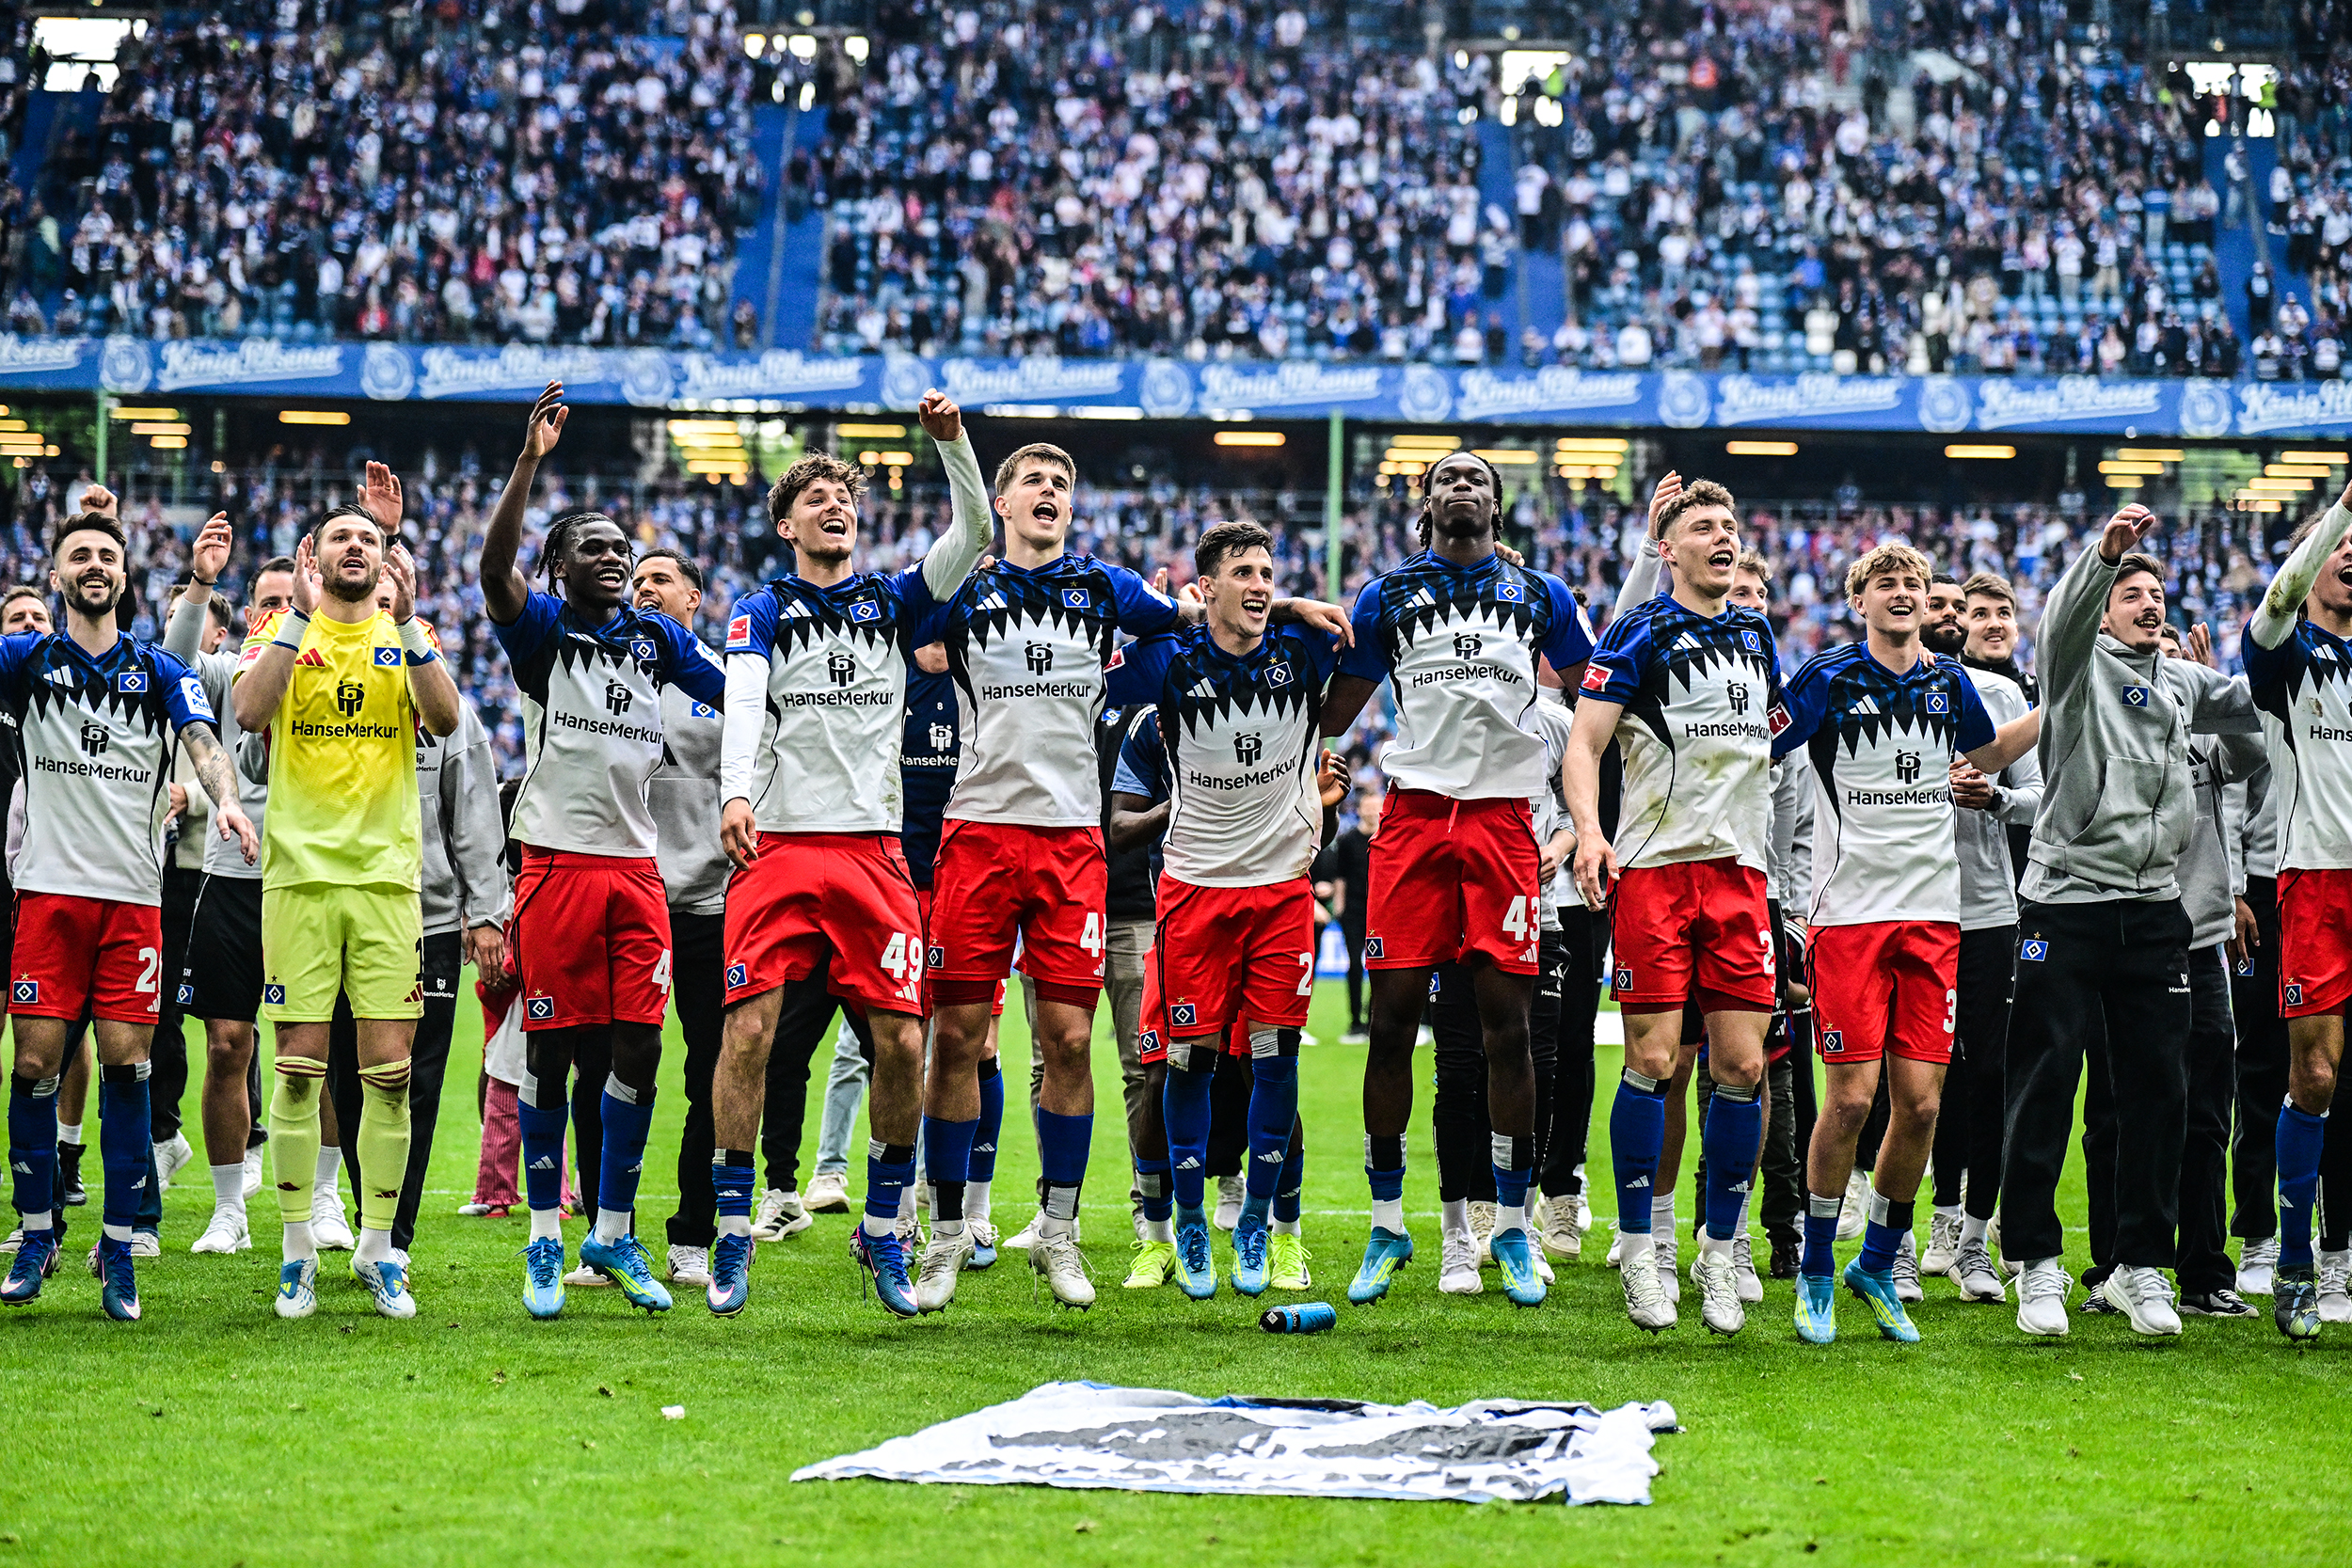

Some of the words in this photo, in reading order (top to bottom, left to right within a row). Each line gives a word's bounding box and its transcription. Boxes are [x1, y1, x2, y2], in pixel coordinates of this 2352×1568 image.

[982, 682, 1091, 701] HanseMerkur
[1412, 664, 1523, 688] HanseMerkur
[782, 691, 894, 707] HanseMerkur
[937, 703, 944, 711] 8
[291, 720, 399, 739] HanseMerkur
[553, 710, 663, 745] HanseMerkur
[34, 754, 151, 784] HanseMerkur
[899, 754, 959, 767] HanseMe
[1189, 753, 1298, 791] HanseMerkur
[1080, 911, 1107, 958] 4
[1502, 895, 1541, 942] 43
[135, 946, 162, 993] 2
[881, 931, 924, 979] 49
[1759, 929, 1775, 974] 2
[651, 948, 672, 995] 4
[1296, 951, 1313, 996] 2
[1943, 988, 1958, 1034] 3
